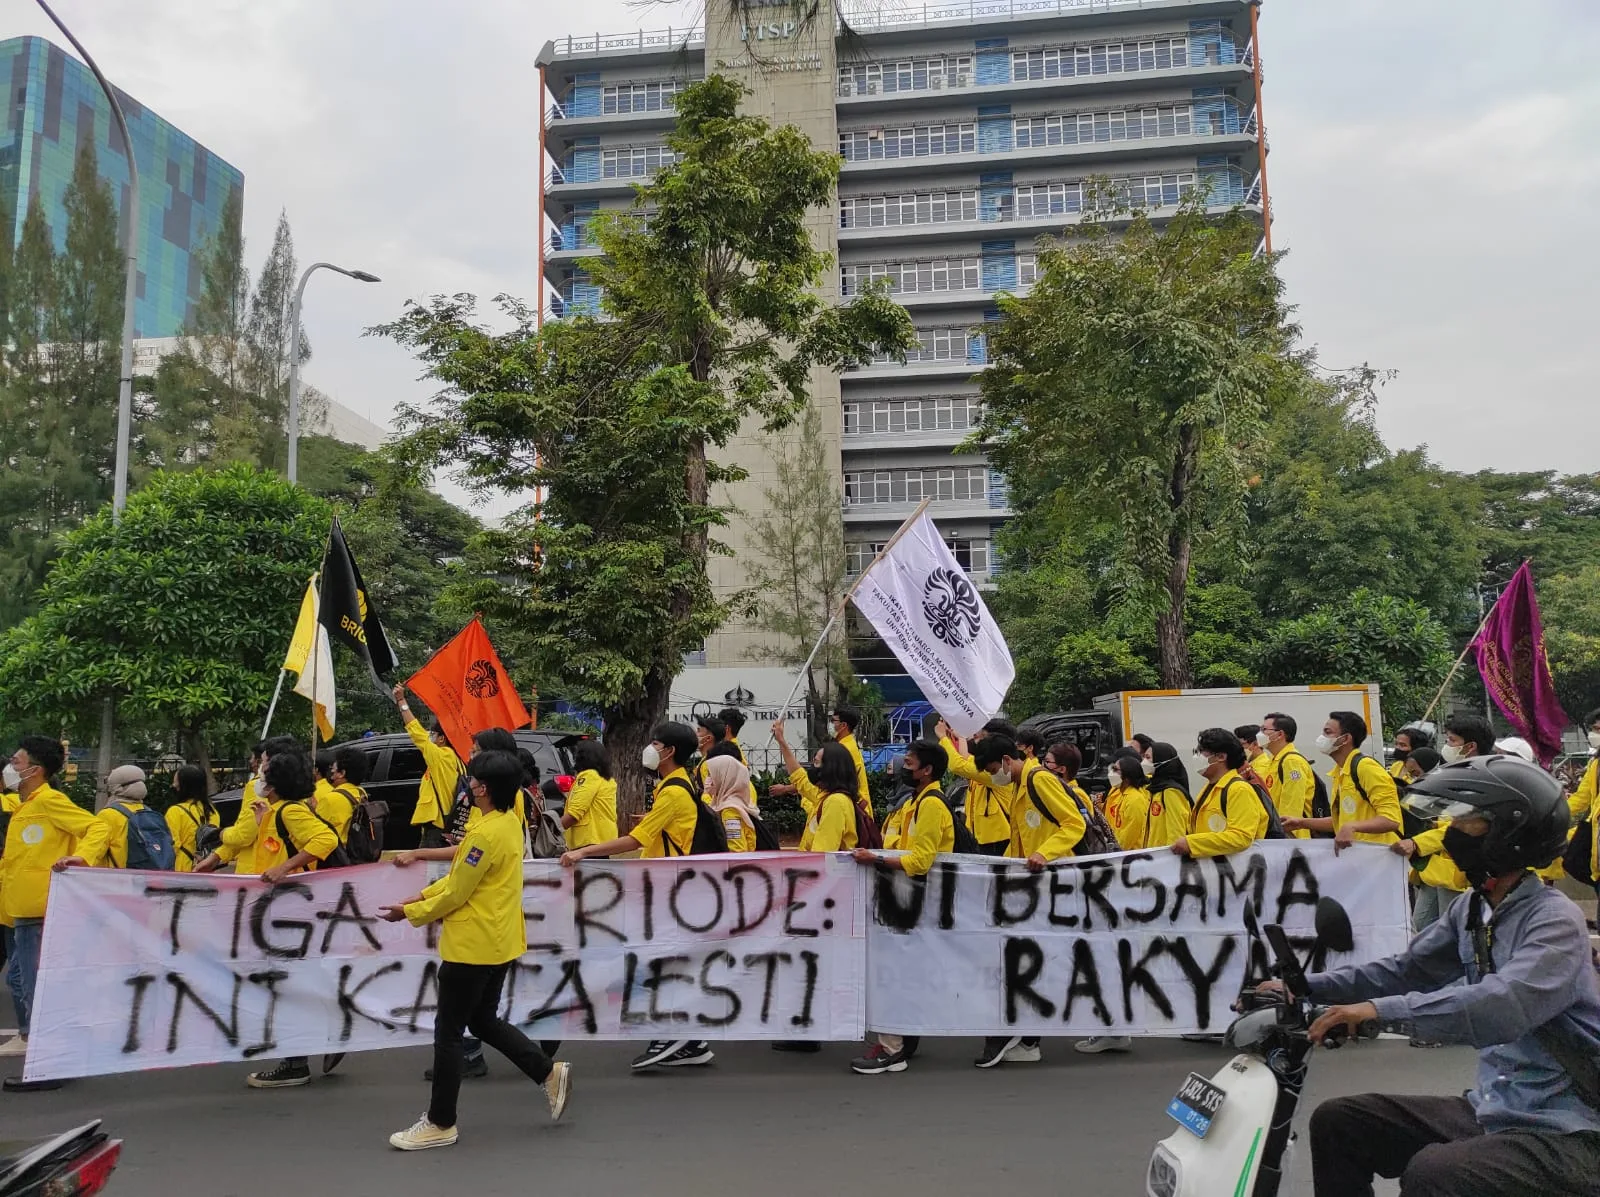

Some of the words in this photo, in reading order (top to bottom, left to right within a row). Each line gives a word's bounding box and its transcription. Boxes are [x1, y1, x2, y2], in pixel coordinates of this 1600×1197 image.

[340, 614, 368, 646] BRIG
[872, 587, 902, 622] FAKULTAS
[951, 689, 975, 718] BUDAYA
[753, 710, 807, 720] TRISKTI
[918, 662, 949, 699] INDONESIA
[144, 881, 382, 959] TIGA
[873, 861, 958, 935] UI
[991, 847, 1319, 929] BERSAMA
[122, 970, 289, 1058] INI
[338, 958, 598, 1042] KATA
[618, 949, 820, 1031] LESTI
